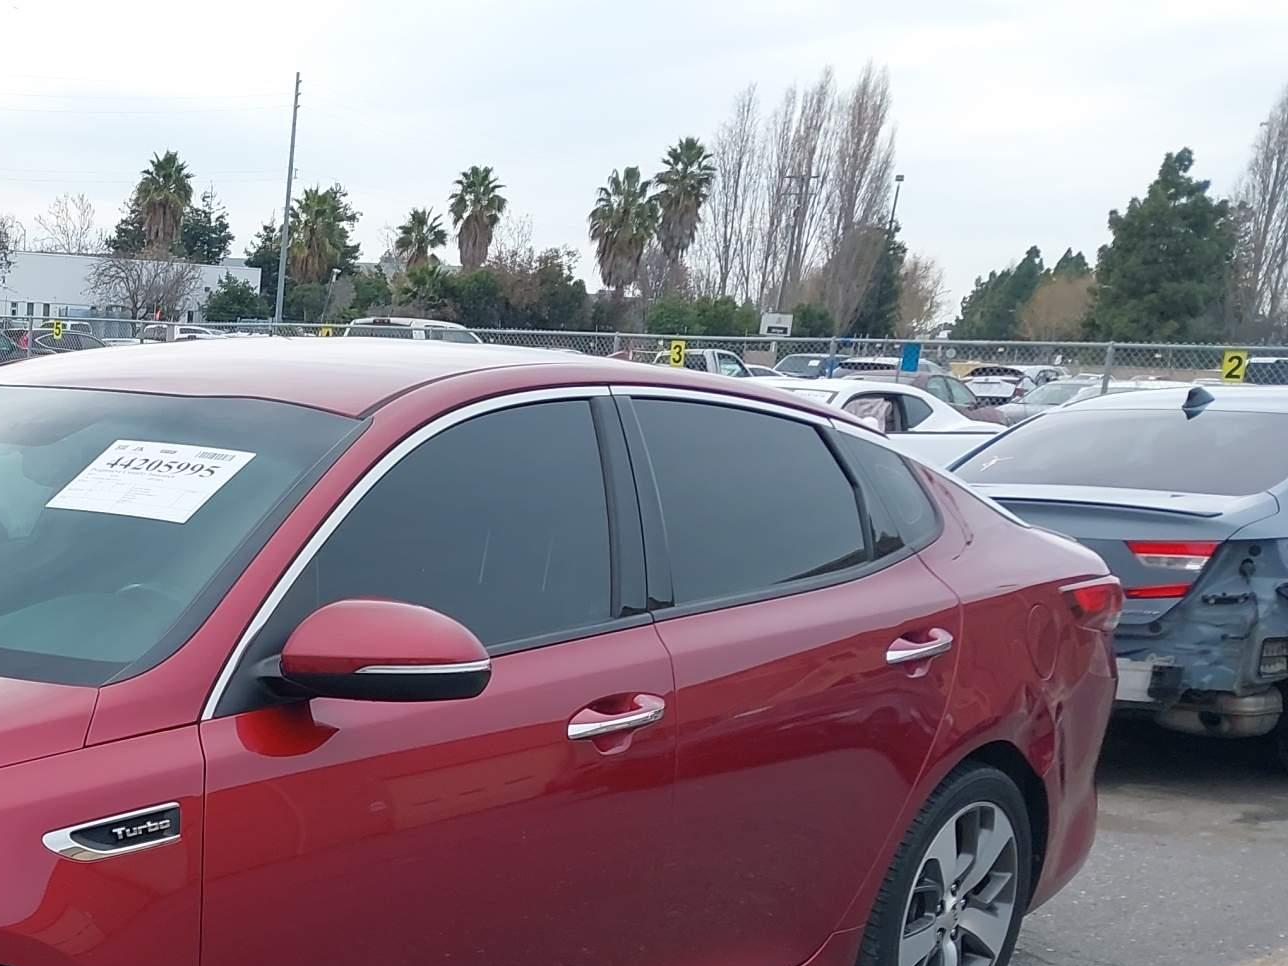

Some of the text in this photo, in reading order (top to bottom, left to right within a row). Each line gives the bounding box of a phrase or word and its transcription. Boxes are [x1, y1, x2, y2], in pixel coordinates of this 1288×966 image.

[54, 321, 61, 337] 5
[672, 344, 683, 364] 3
[1224, 355, 1243, 379] 2
[106, 456, 223, 478] 44205995
[112, 819, 171, 840] Turbo
